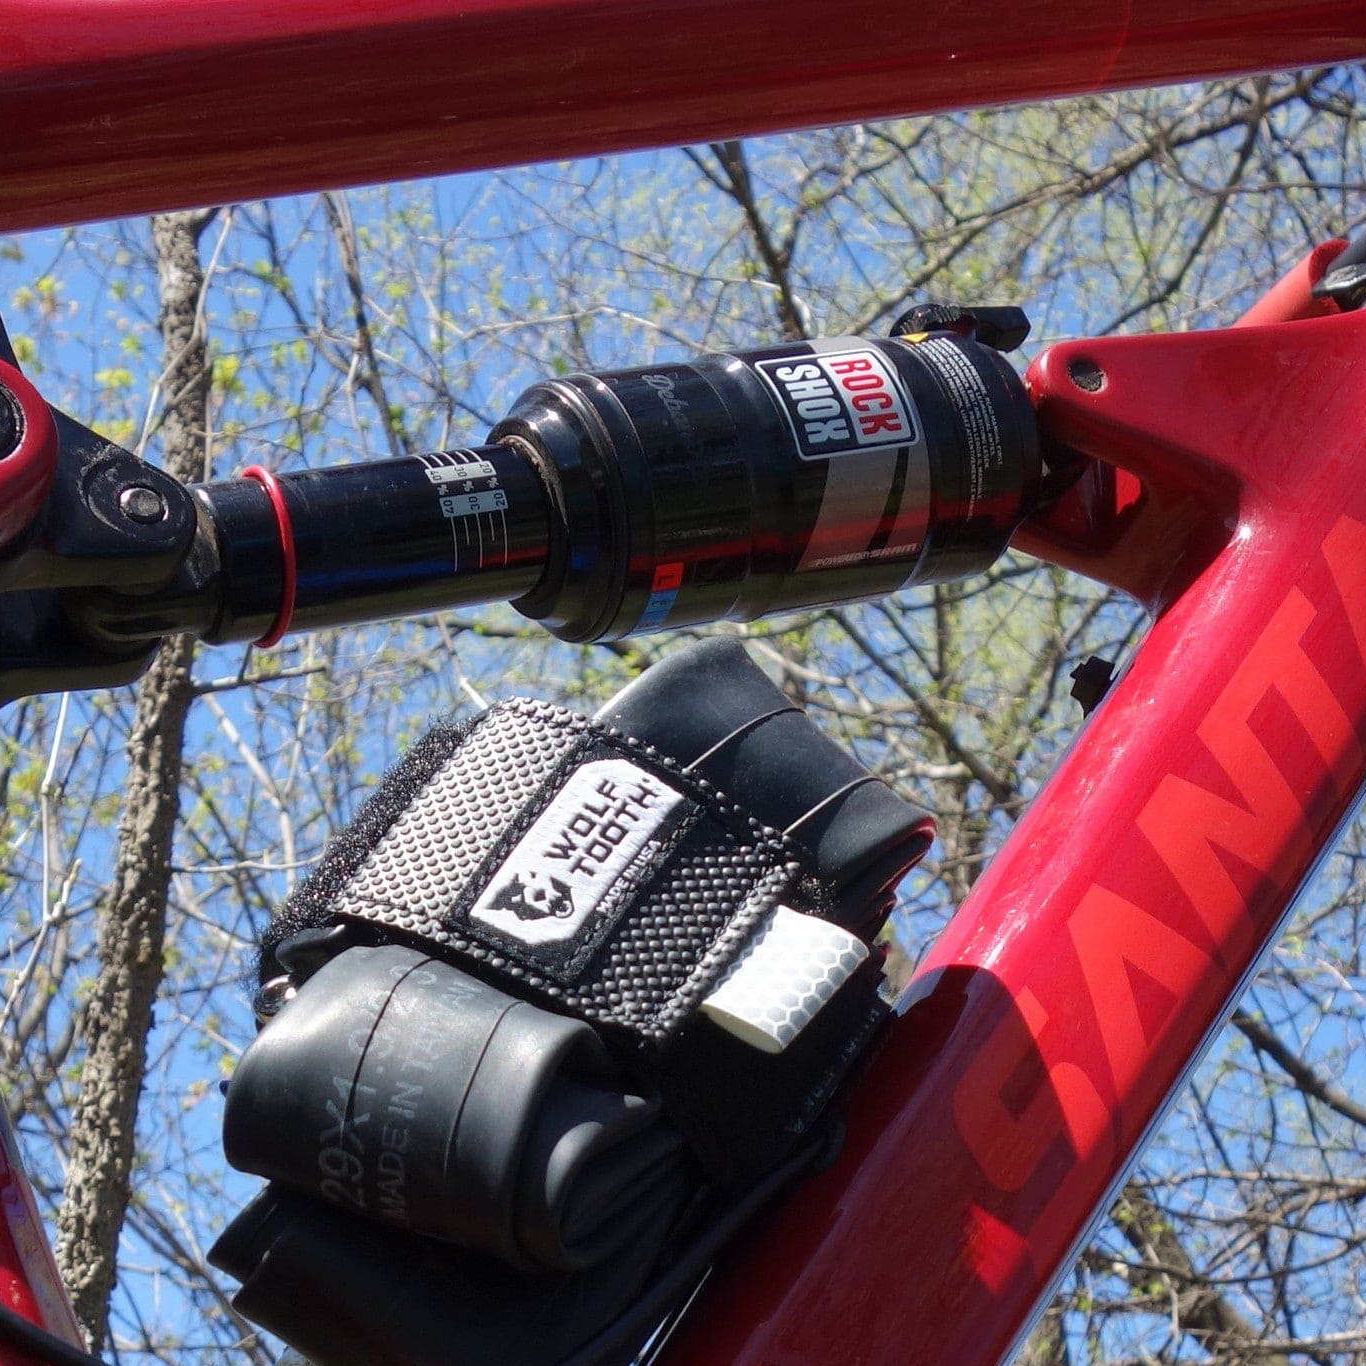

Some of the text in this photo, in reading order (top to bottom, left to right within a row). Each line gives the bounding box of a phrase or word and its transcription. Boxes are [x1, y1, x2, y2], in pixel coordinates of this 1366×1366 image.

[775, 363, 851, 445] SHOX
[829, 356, 903, 437] ROCK
[543, 778, 618, 861] WOLF
[570, 783, 660, 877] TOOTH
[595, 876, 630, 915] MADE
[633, 839, 662, 871] USA
[386, 1081, 424, 1119] IN
[376, 1125, 414, 1220] MADE
